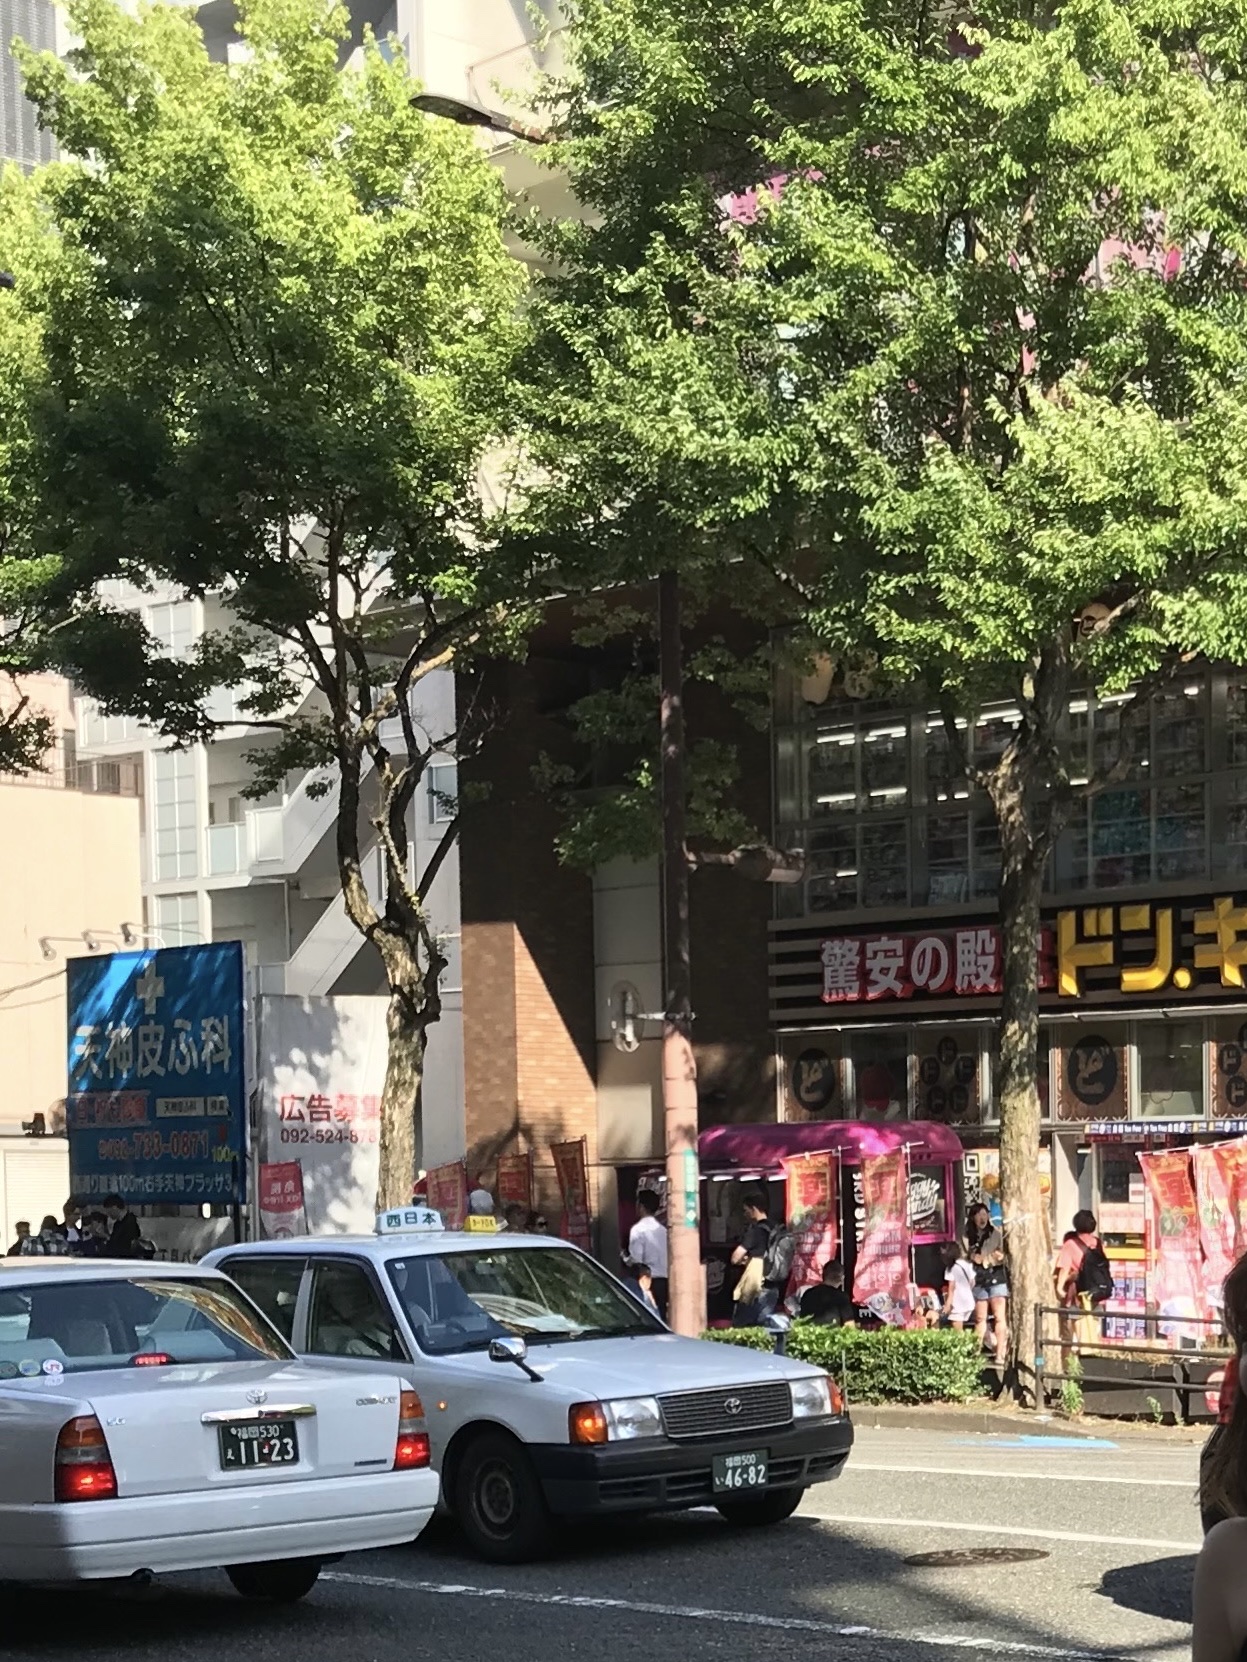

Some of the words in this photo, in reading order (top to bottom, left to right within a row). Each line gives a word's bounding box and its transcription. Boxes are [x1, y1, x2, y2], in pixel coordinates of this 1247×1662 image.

[821, 929, 1045, 1003] 驚安の殿
[71, 1015, 232, 1081] 天神皮ふ科
[387, 1211, 437, 1228] 西日本
[724, 1464, 766, 1489] 46-82
